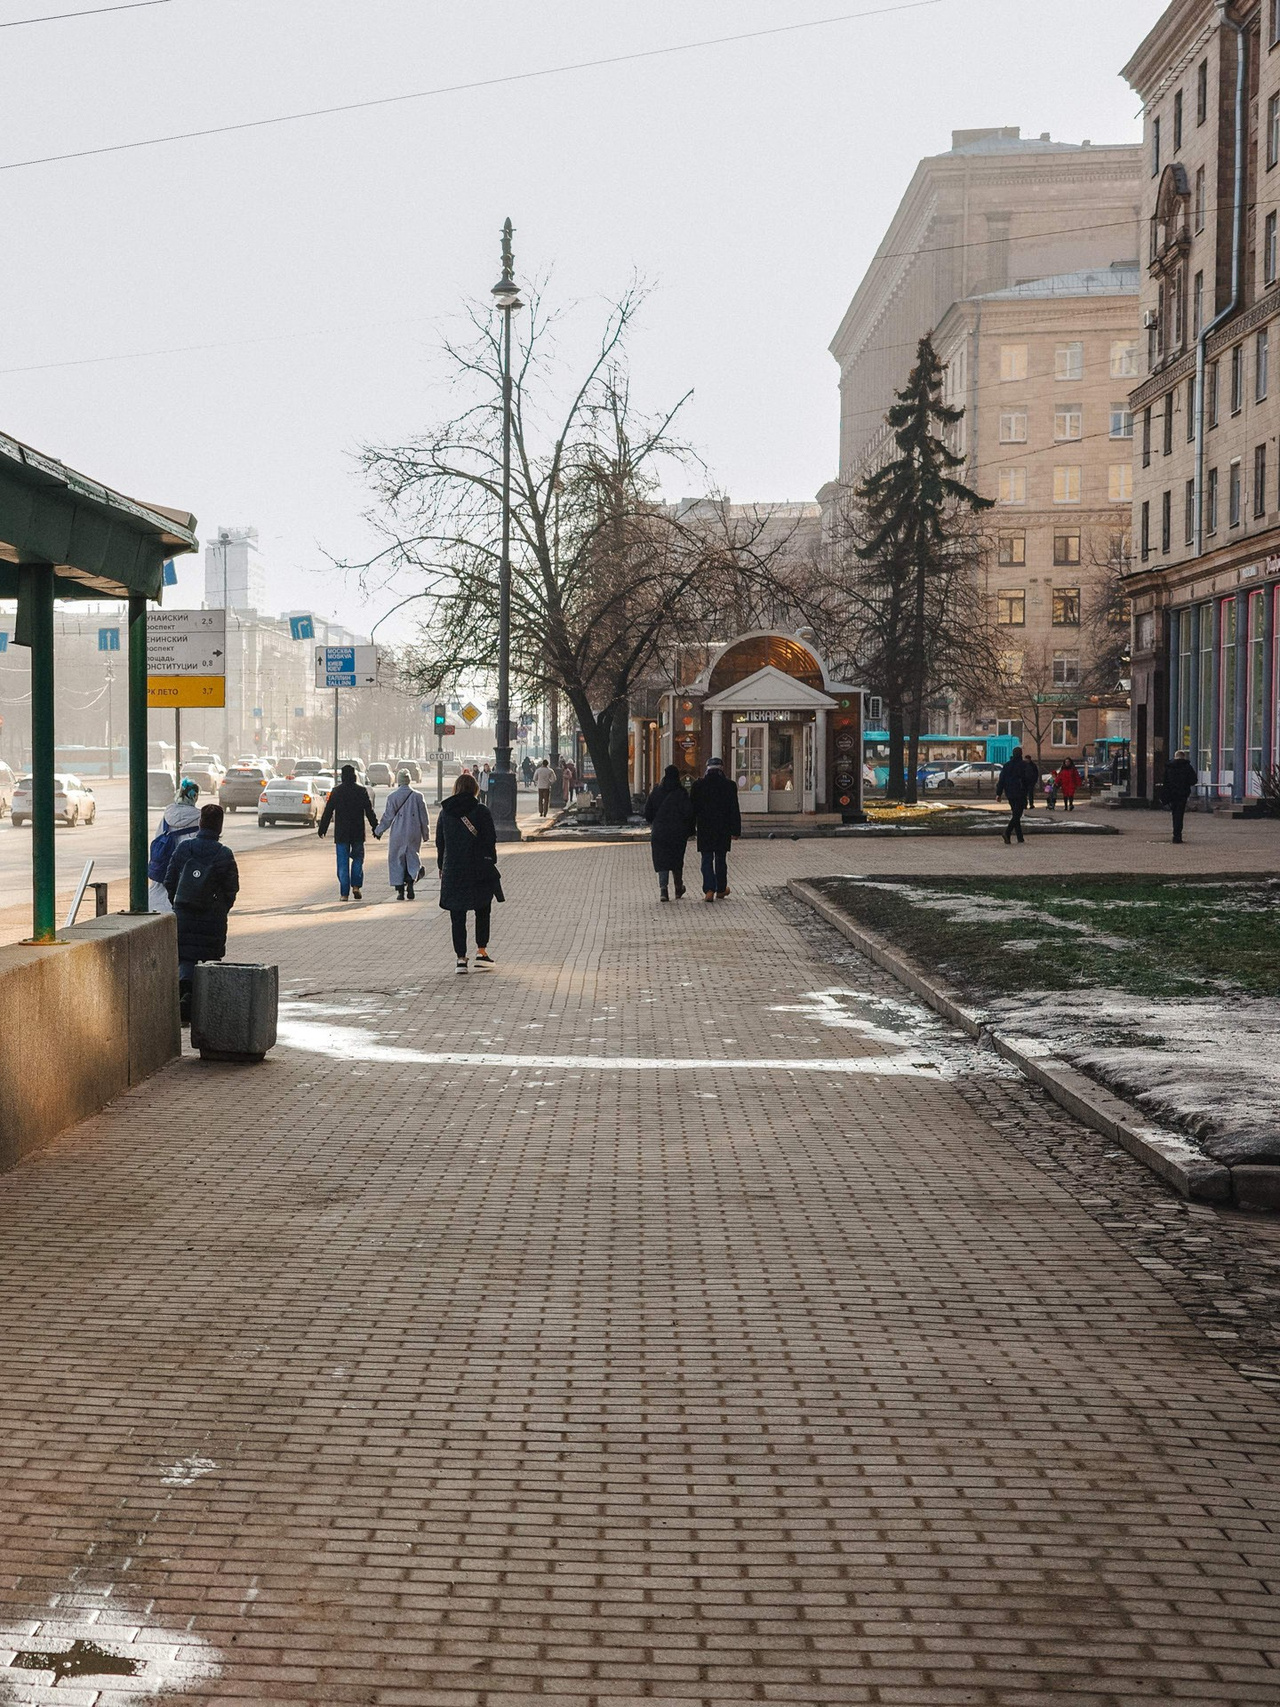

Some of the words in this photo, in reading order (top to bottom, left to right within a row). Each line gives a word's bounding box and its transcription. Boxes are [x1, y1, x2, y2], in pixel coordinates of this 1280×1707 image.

[147, 613, 189, 621] УНАЙСКИЙ
[147, 663, 198, 671] ОНСТИТУЦИИ
[202, 687, 214, 695] 3,7
